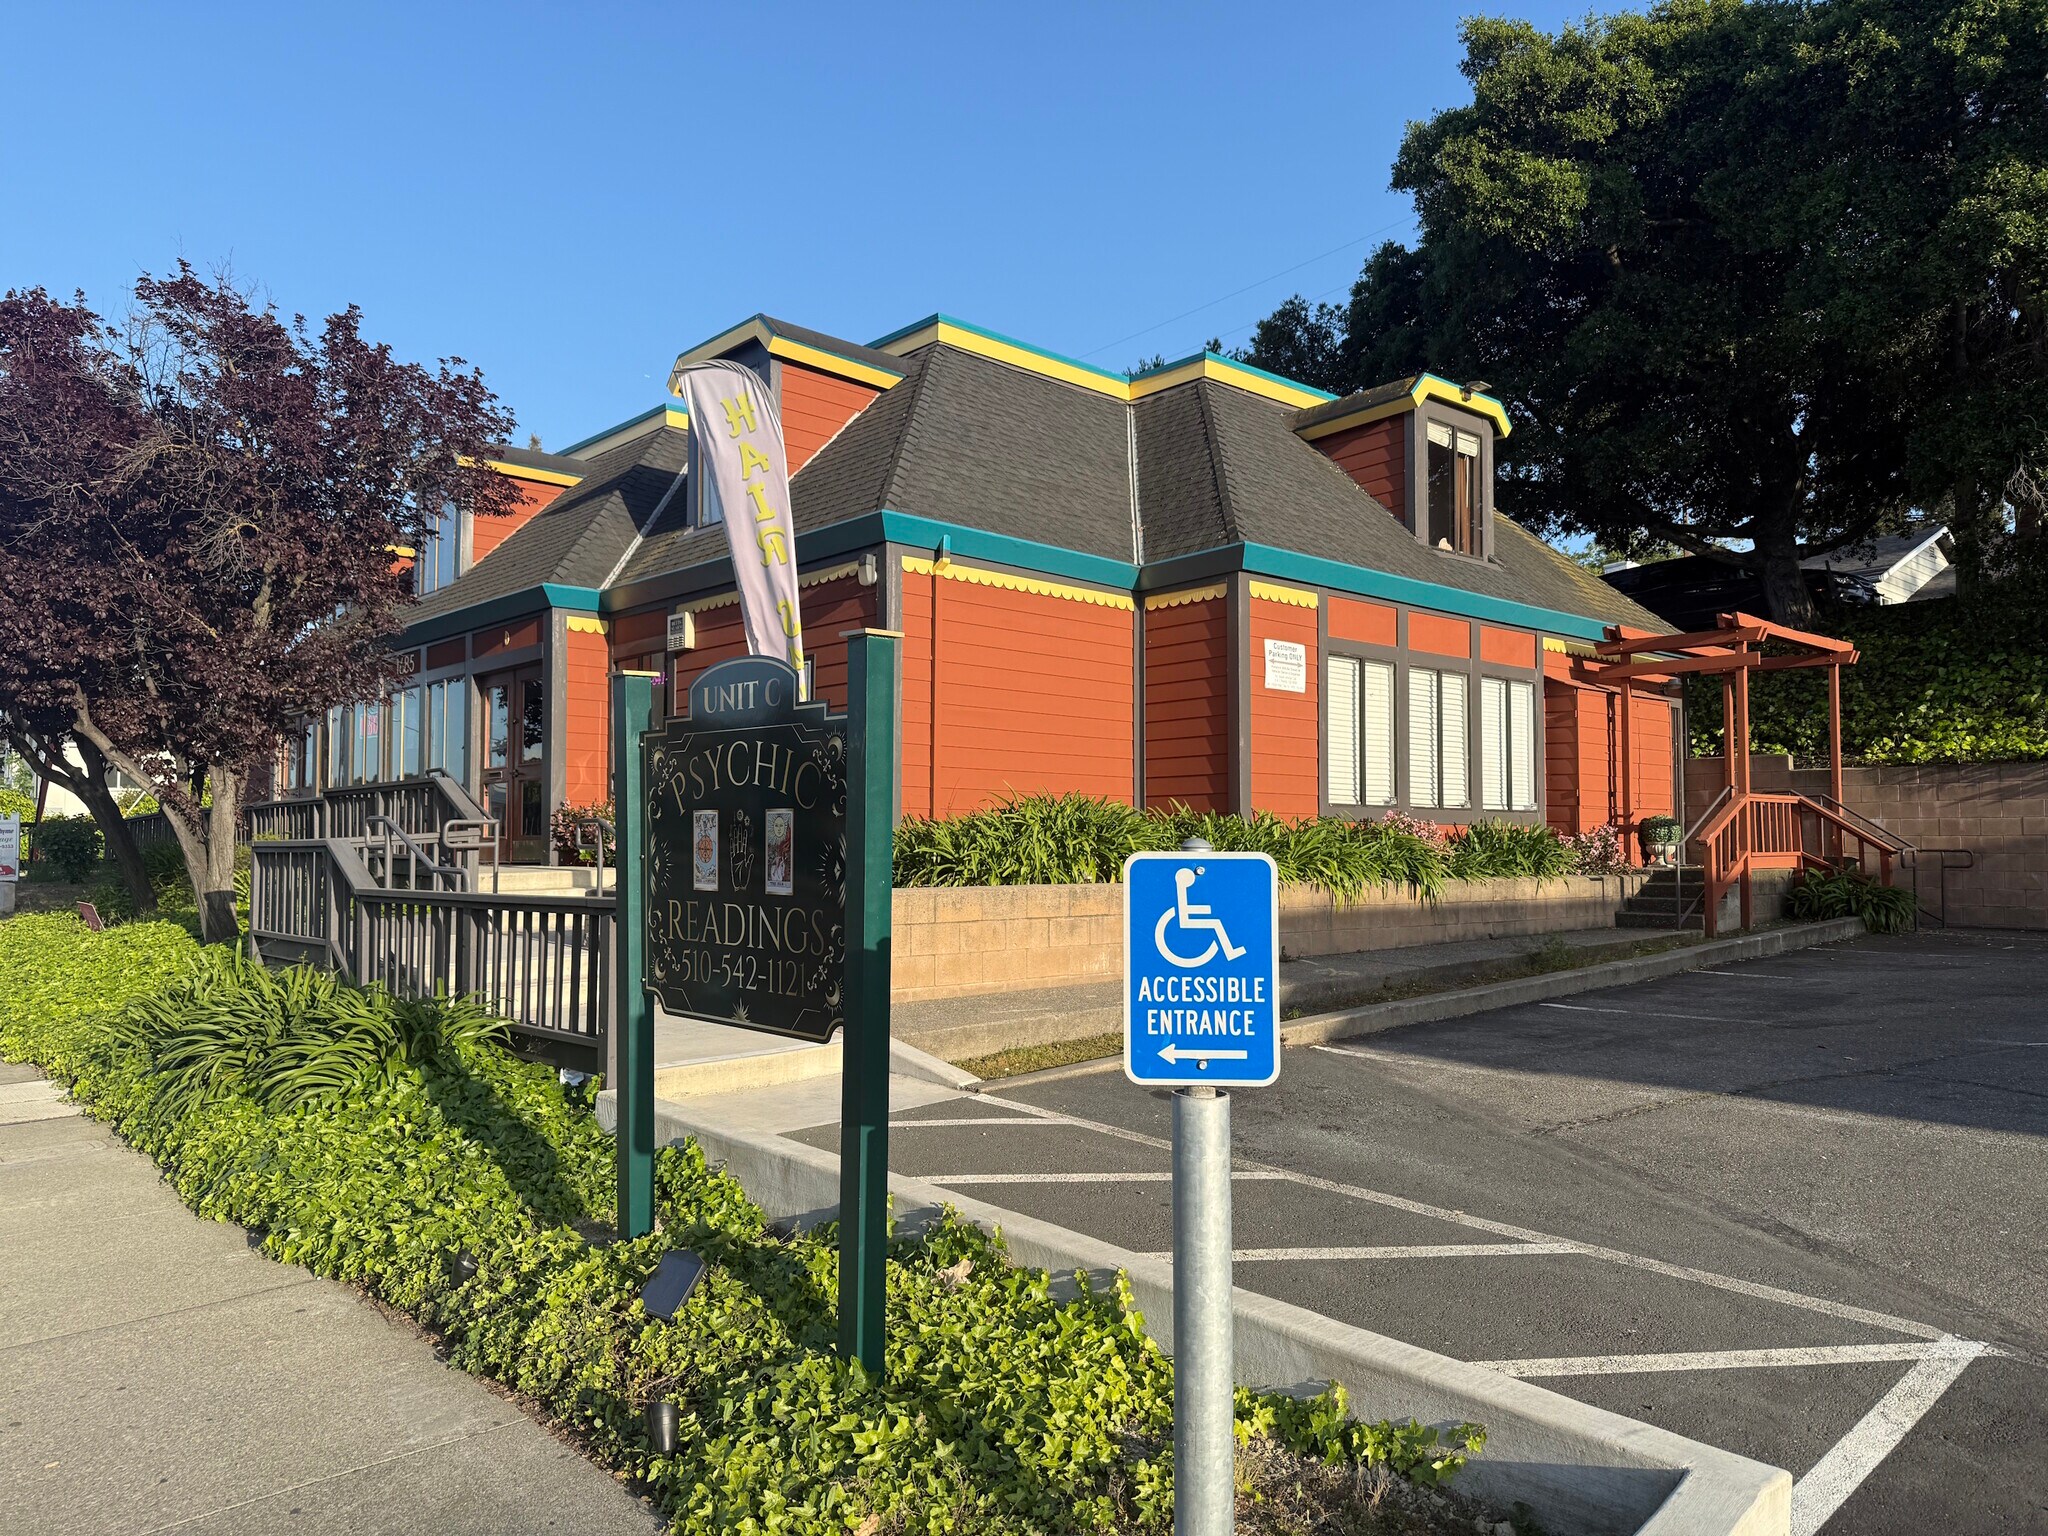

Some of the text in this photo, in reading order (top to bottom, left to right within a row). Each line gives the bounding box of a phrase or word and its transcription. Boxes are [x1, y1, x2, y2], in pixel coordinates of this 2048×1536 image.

[1268, 649, 1302, 661] Parking ONLY
[1273, 642, 1297, 653] Customer
[703, 678, 781, 714] UNIT C
[670, 740, 822, 816] PSYCHIC
[668, 899, 825, 956] READINGS
[682, 949, 806, 998] 510-542-1121
[1138, 976, 1266, 1003] ACCESSIBLE
[1147, 1009, 1256, 1036] ENTRANCE
